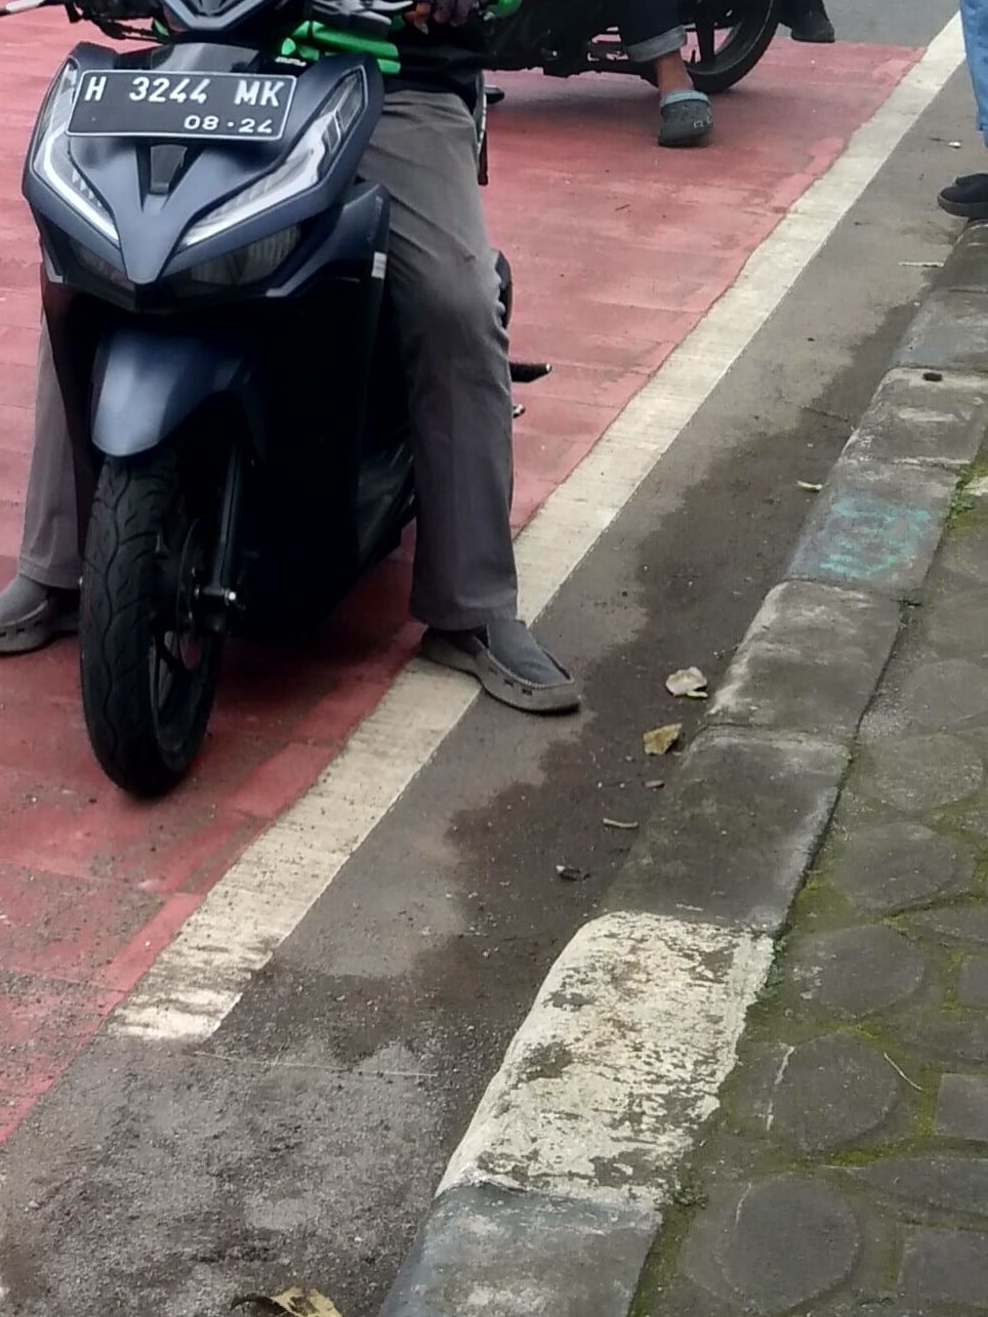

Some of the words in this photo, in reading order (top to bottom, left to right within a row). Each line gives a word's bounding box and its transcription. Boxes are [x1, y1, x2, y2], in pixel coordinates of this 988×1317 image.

[84, 76, 108, 102] H
[129, 76, 211, 105] 3244
[234, 80, 285, 108] MK
